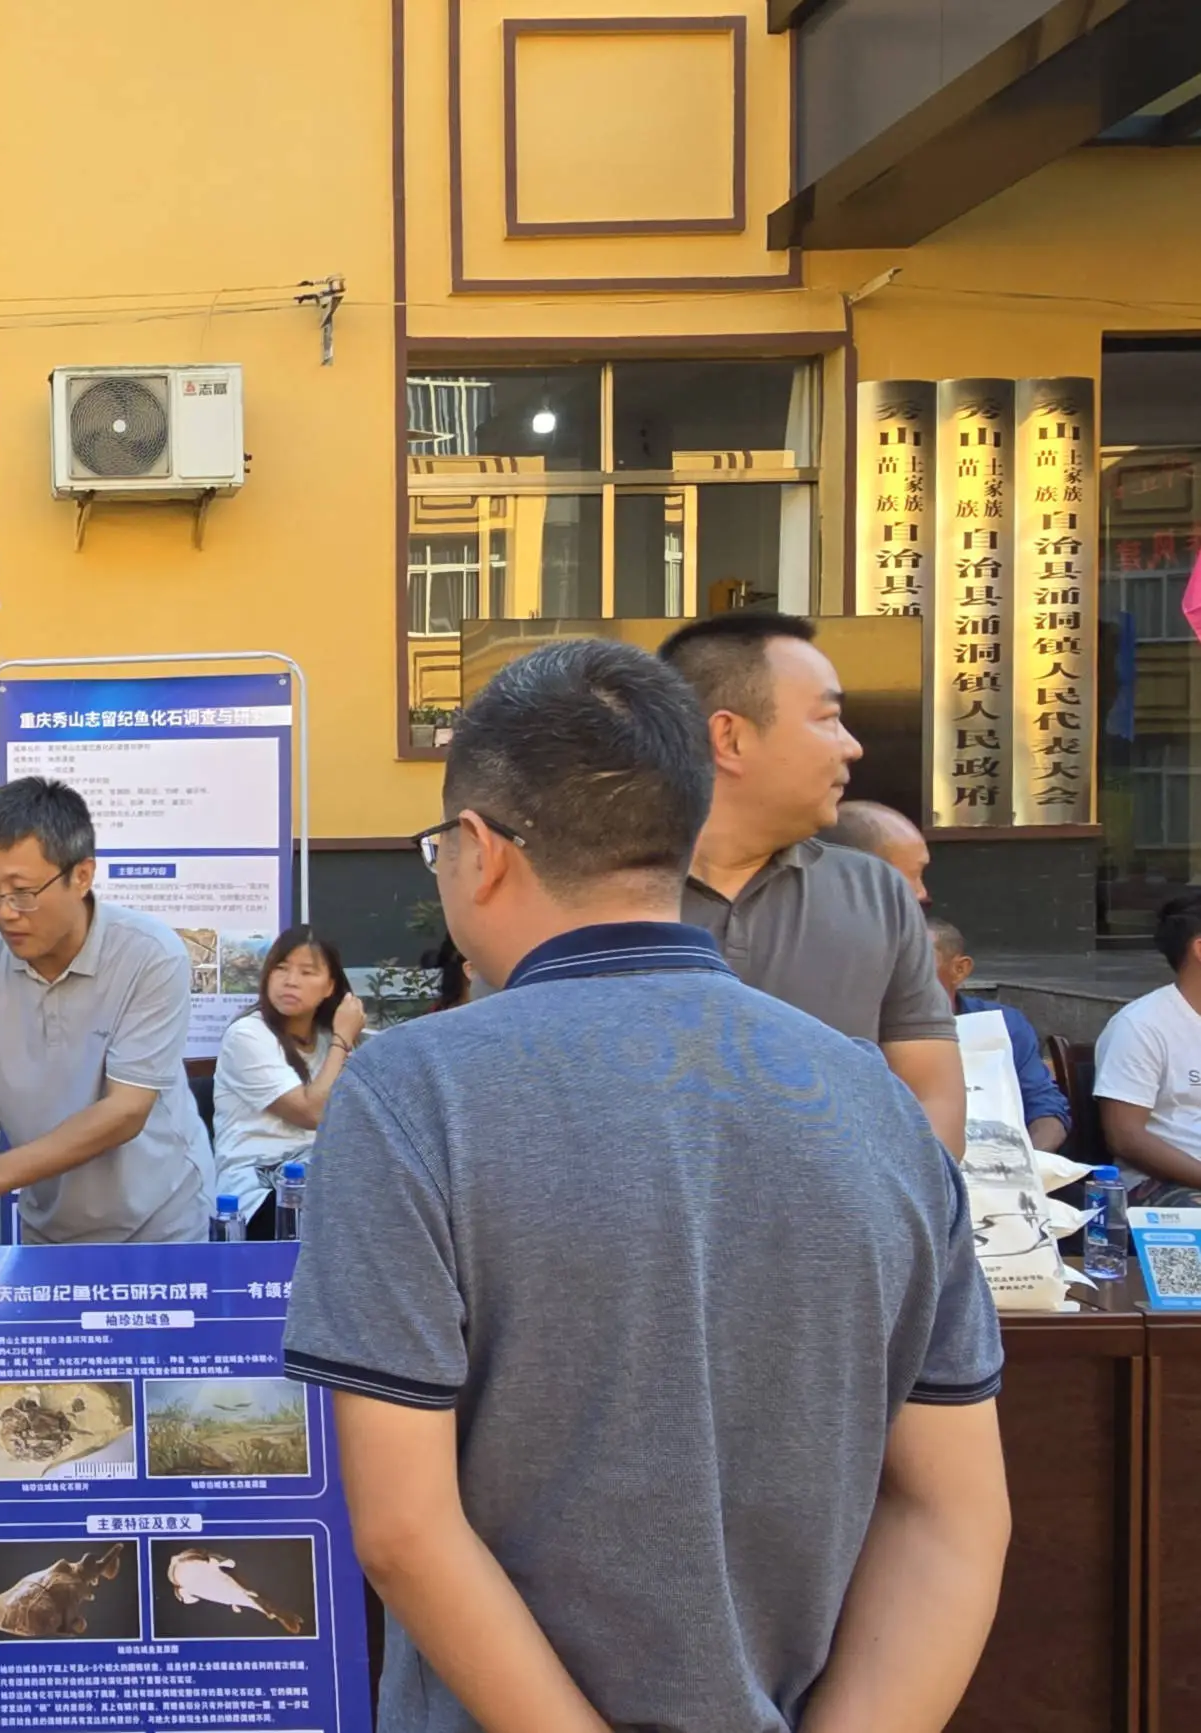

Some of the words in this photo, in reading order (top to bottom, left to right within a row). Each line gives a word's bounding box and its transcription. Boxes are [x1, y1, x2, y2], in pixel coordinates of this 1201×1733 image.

[19, 709, 266, 729] 重庆秀山志留纪鱼化石调查与研
